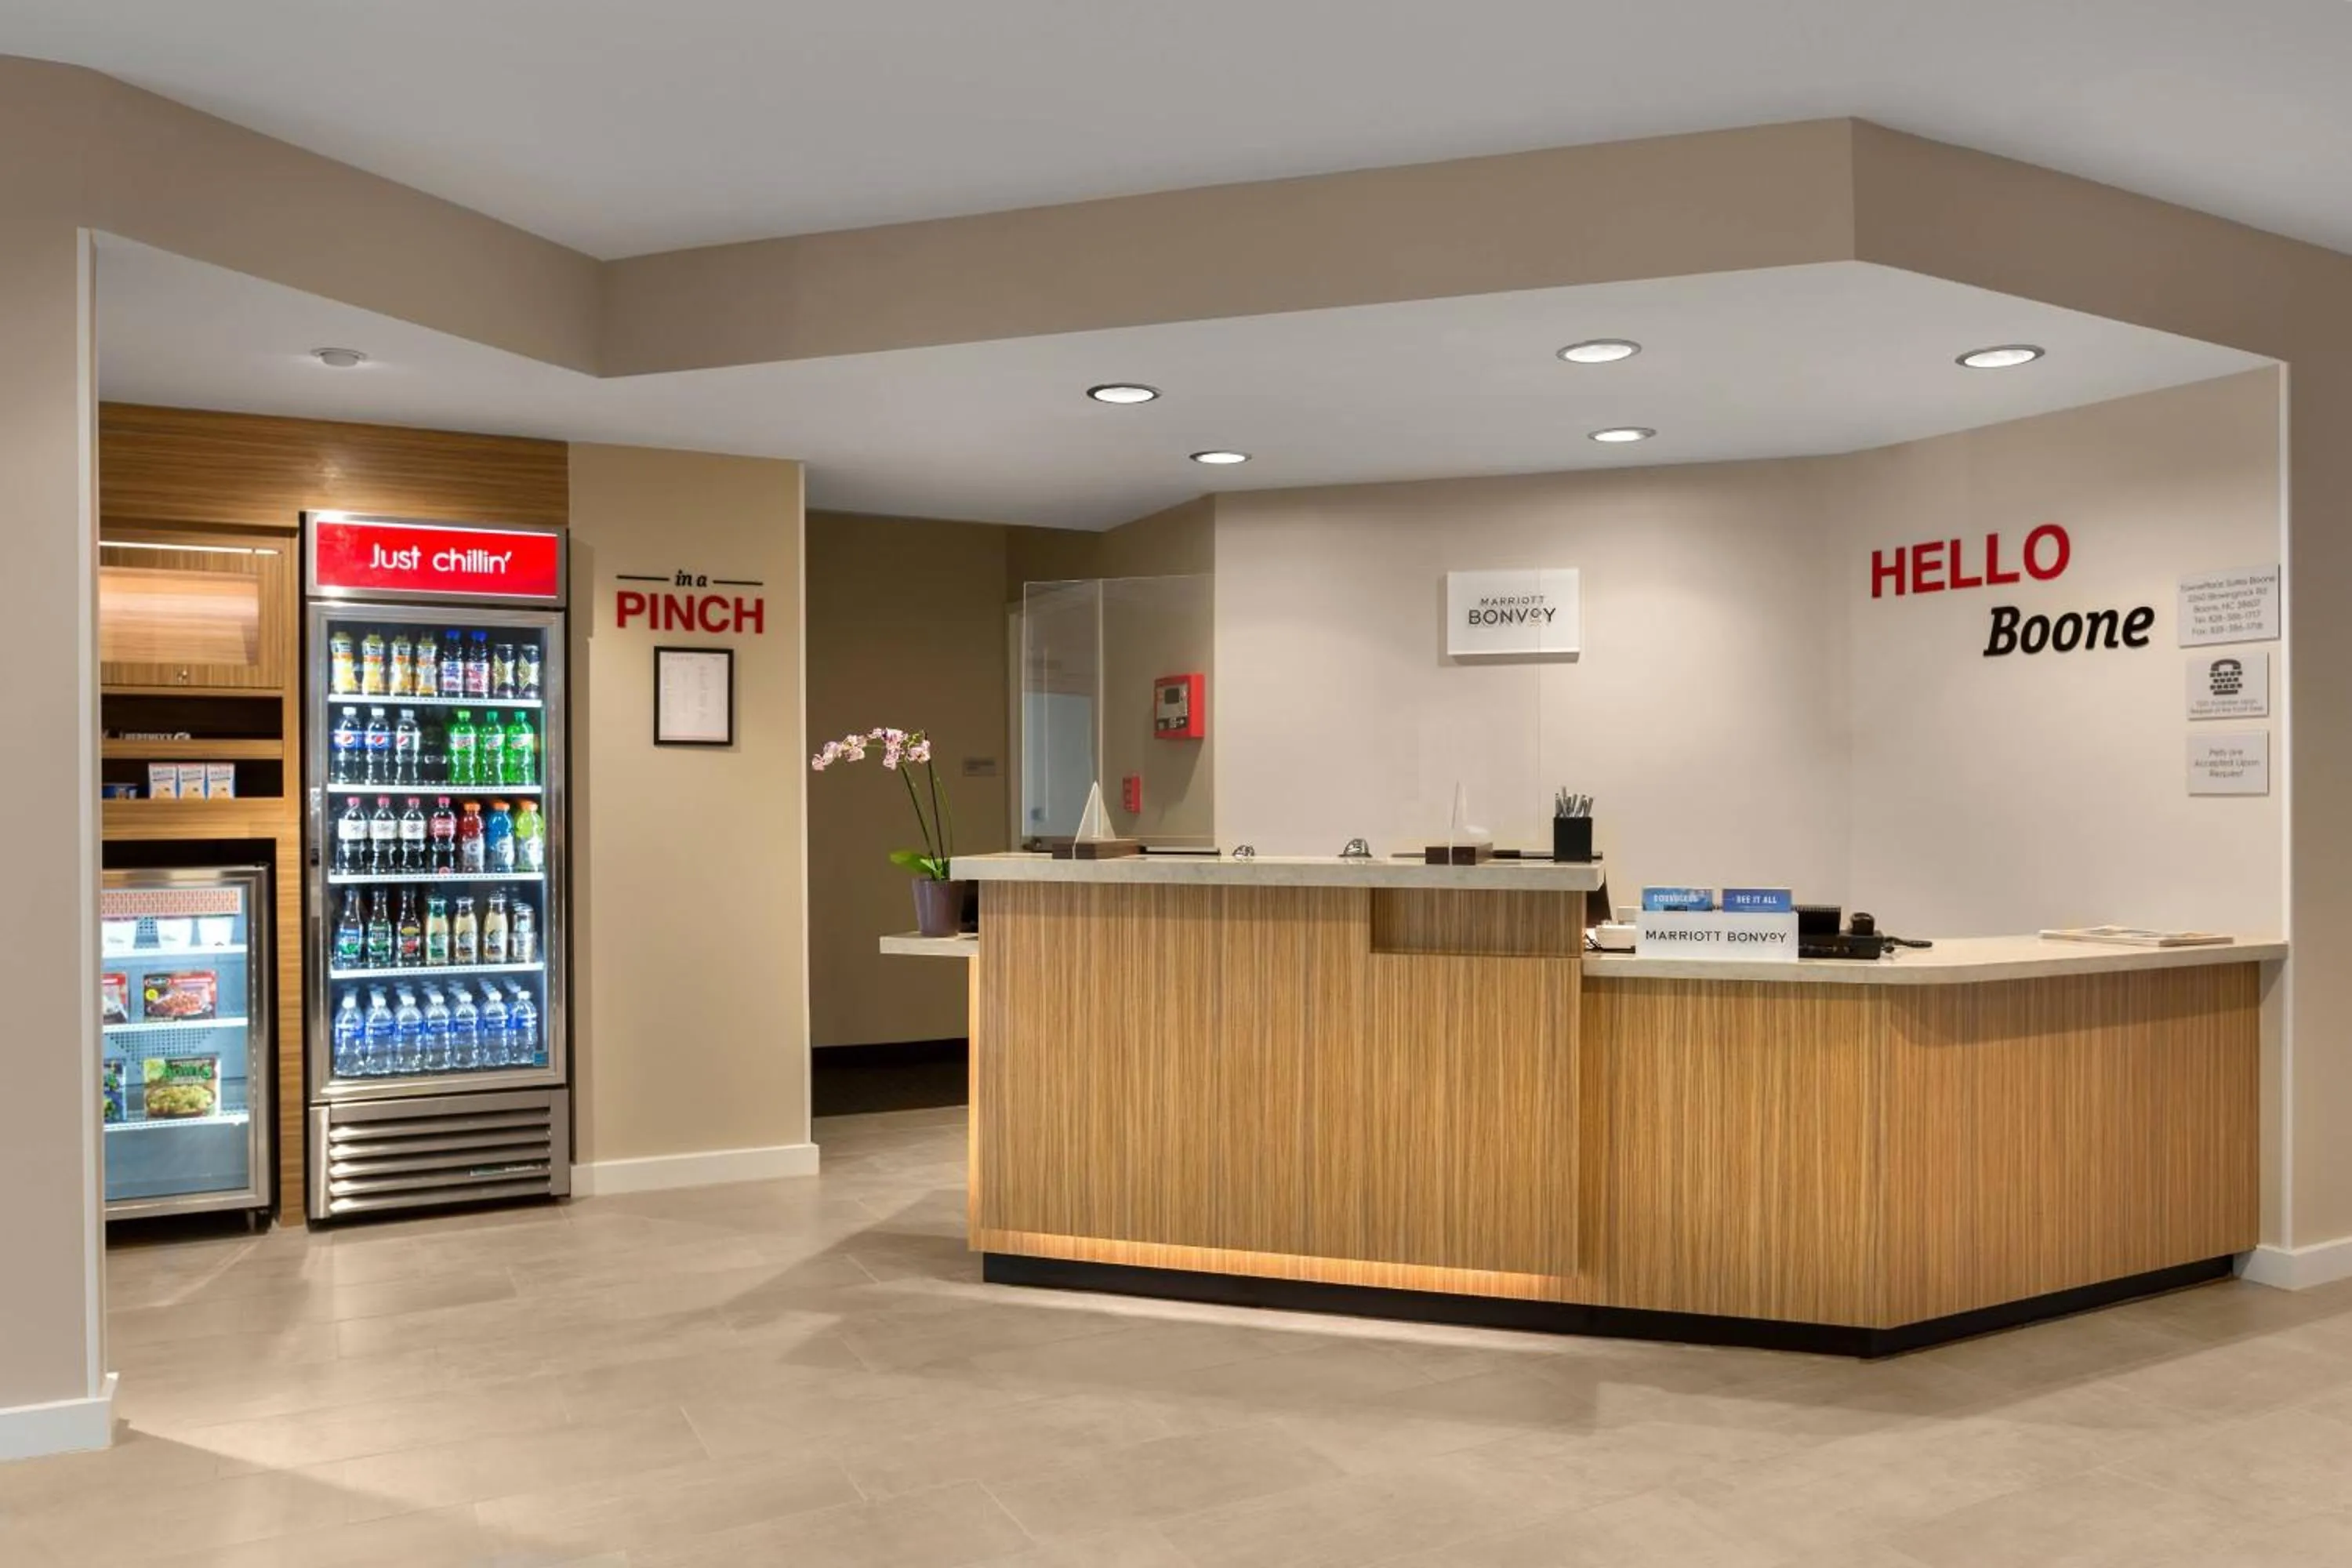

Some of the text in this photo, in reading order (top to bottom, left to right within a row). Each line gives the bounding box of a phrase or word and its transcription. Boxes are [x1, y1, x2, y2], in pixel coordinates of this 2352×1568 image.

[369, 543, 512, 574] Just chillin'
[1871, 524, 2071, 598] HELLO
[674, 569, 707, 587] in a
[1480, 595, 1544, 606] MARRIOTT
[616, 591, 764, 634] PINCH
[1468, 608, 1556, 625] BONVOY
[1983, 605, 2155, 657] Boone
[1763, 895, 1777, 904] ALL
[1646, 930, 1788, 943] MARRIOTT BONVOY
